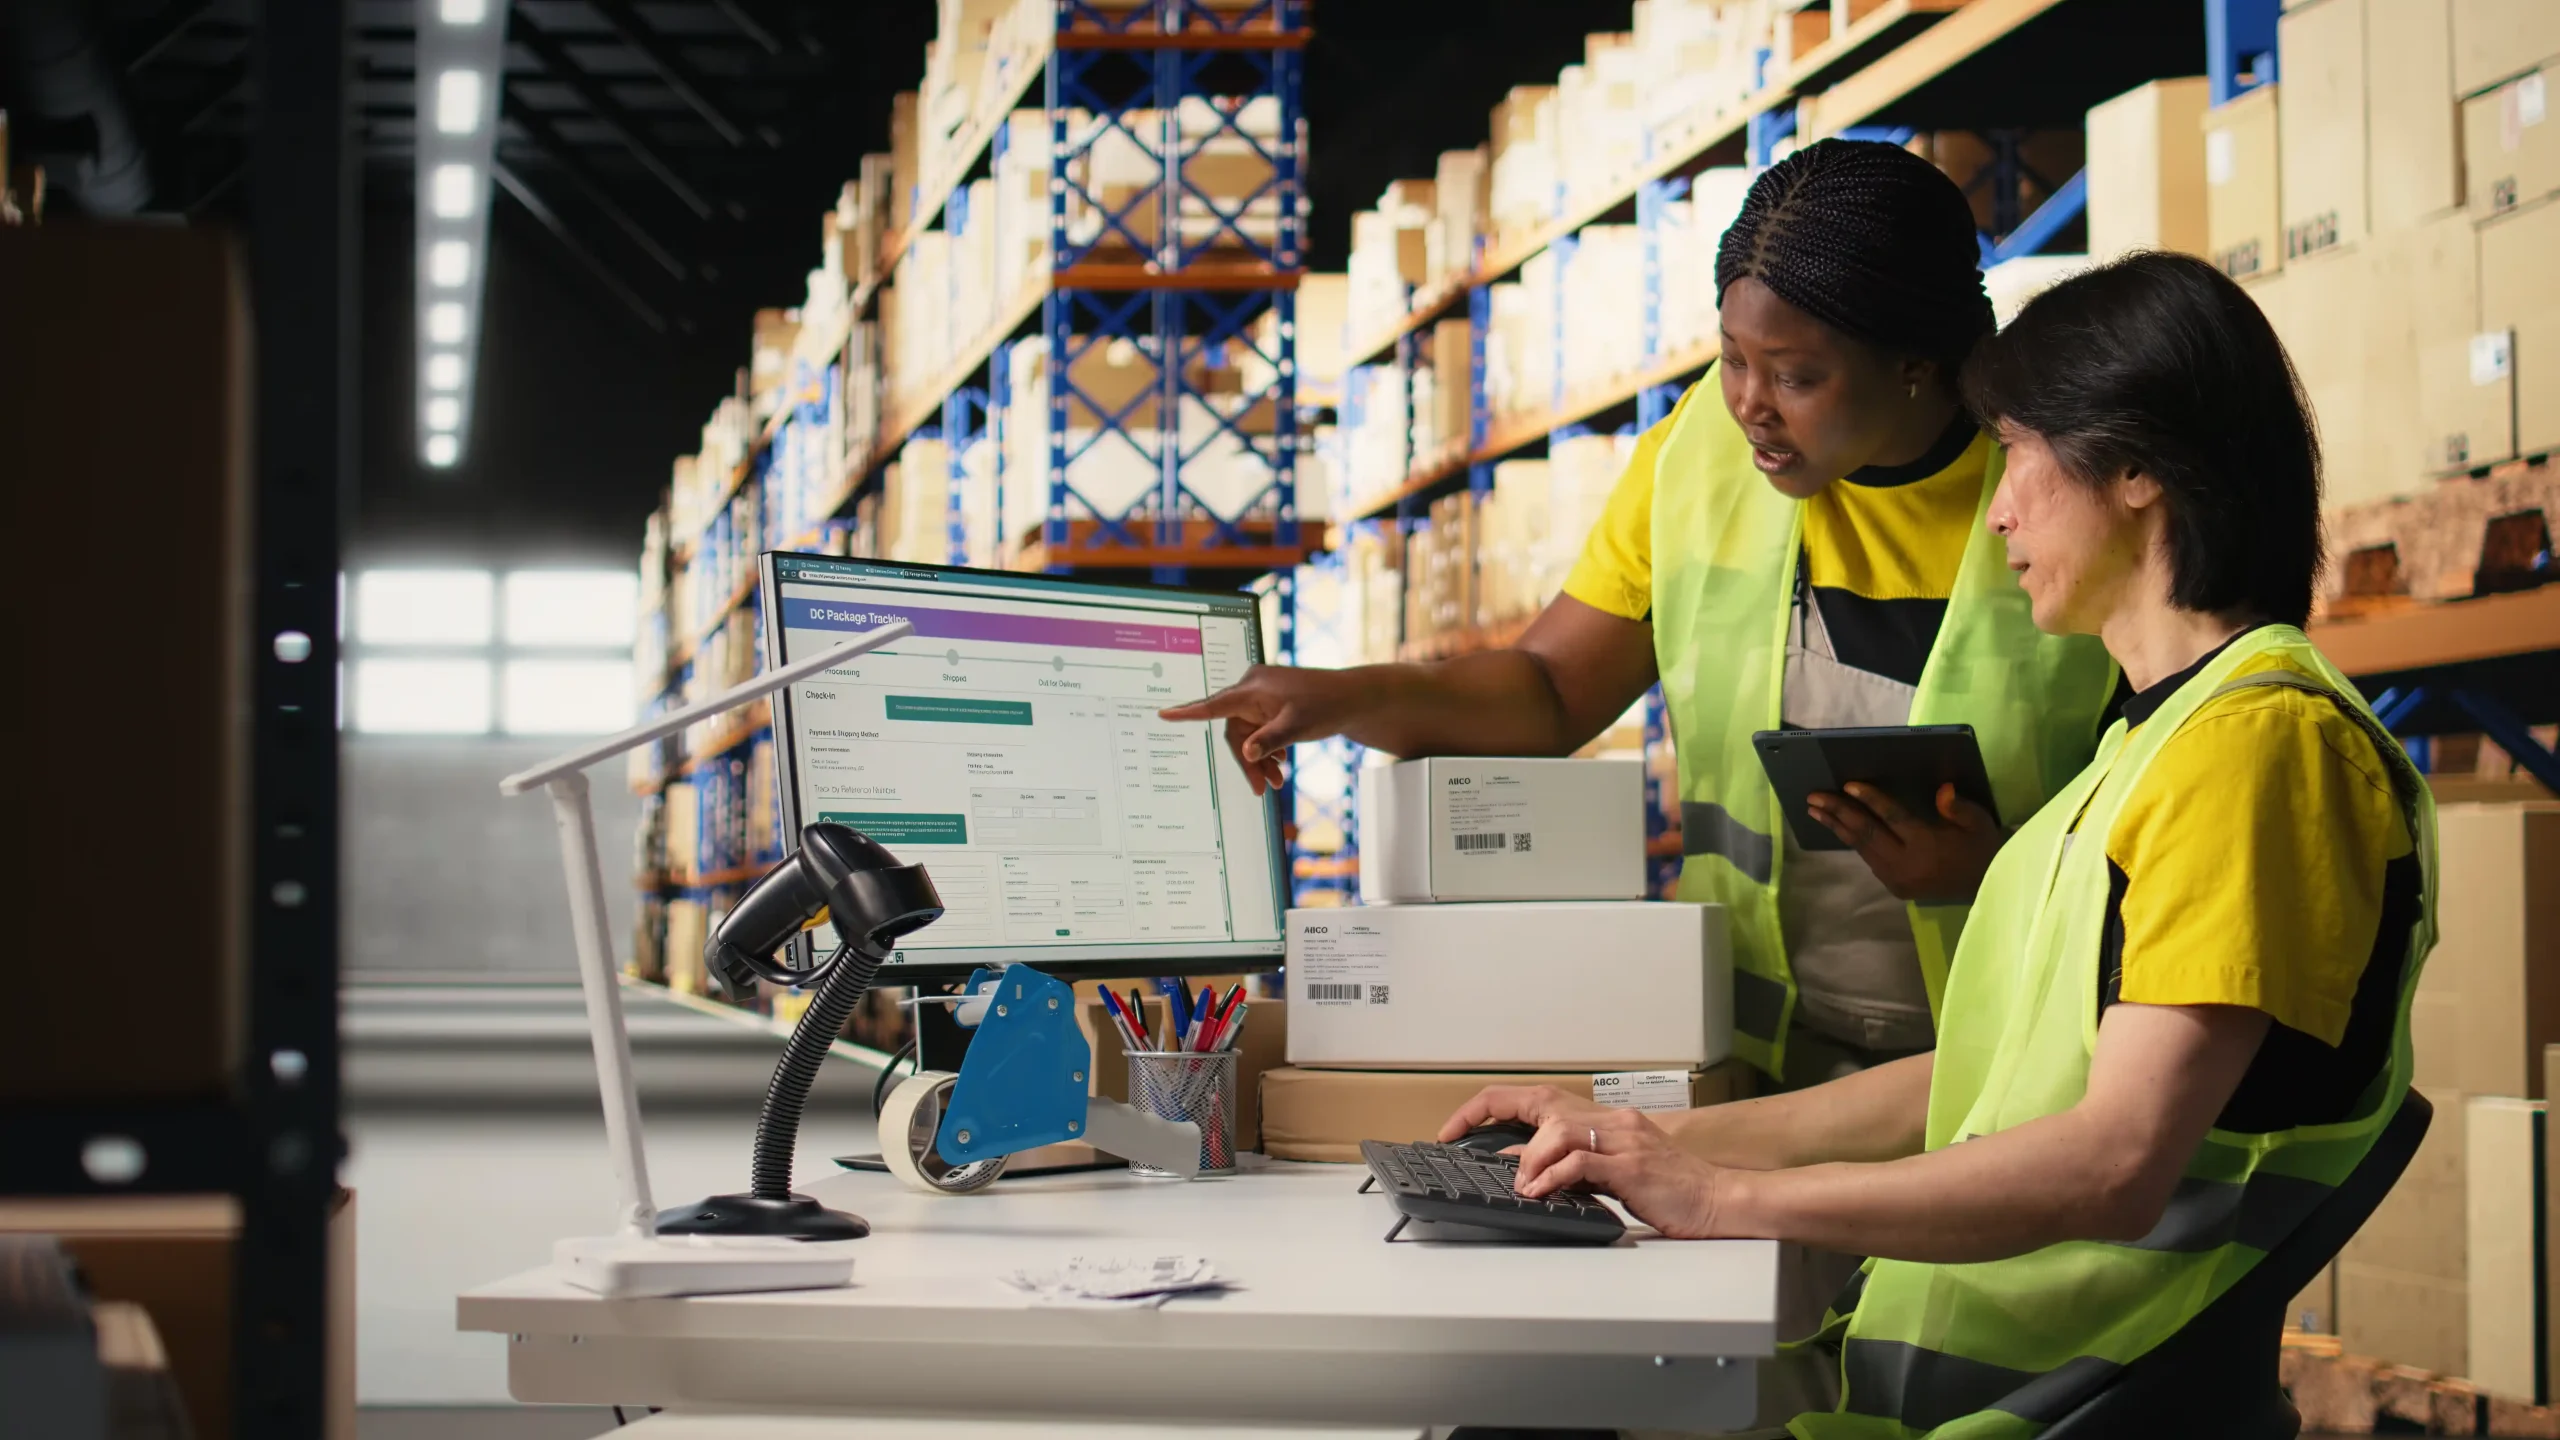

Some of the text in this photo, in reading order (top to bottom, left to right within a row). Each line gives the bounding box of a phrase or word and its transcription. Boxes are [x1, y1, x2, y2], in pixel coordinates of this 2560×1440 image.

[809, 607, 825, 620] DC
[827, 609, 867, 625] Package
[824, 668, 860, 678] Processing
[942, 673, 967, 683] Shipped
[1050, 679, 1058, 687] for
[1059, 680, 1081, 689] Delivery
[1146, 685, 1171, 693] Delivered
[809, 729, 831, 738] Payment
[838, 730, 860, 738] Shipping
[1448, 777, 1471, 785] ABCO
[831, 785, 840, 794] by
[1304, 926, 1328, 934] ABCO
[1593, 1077, 1620, 1087] ABCO
